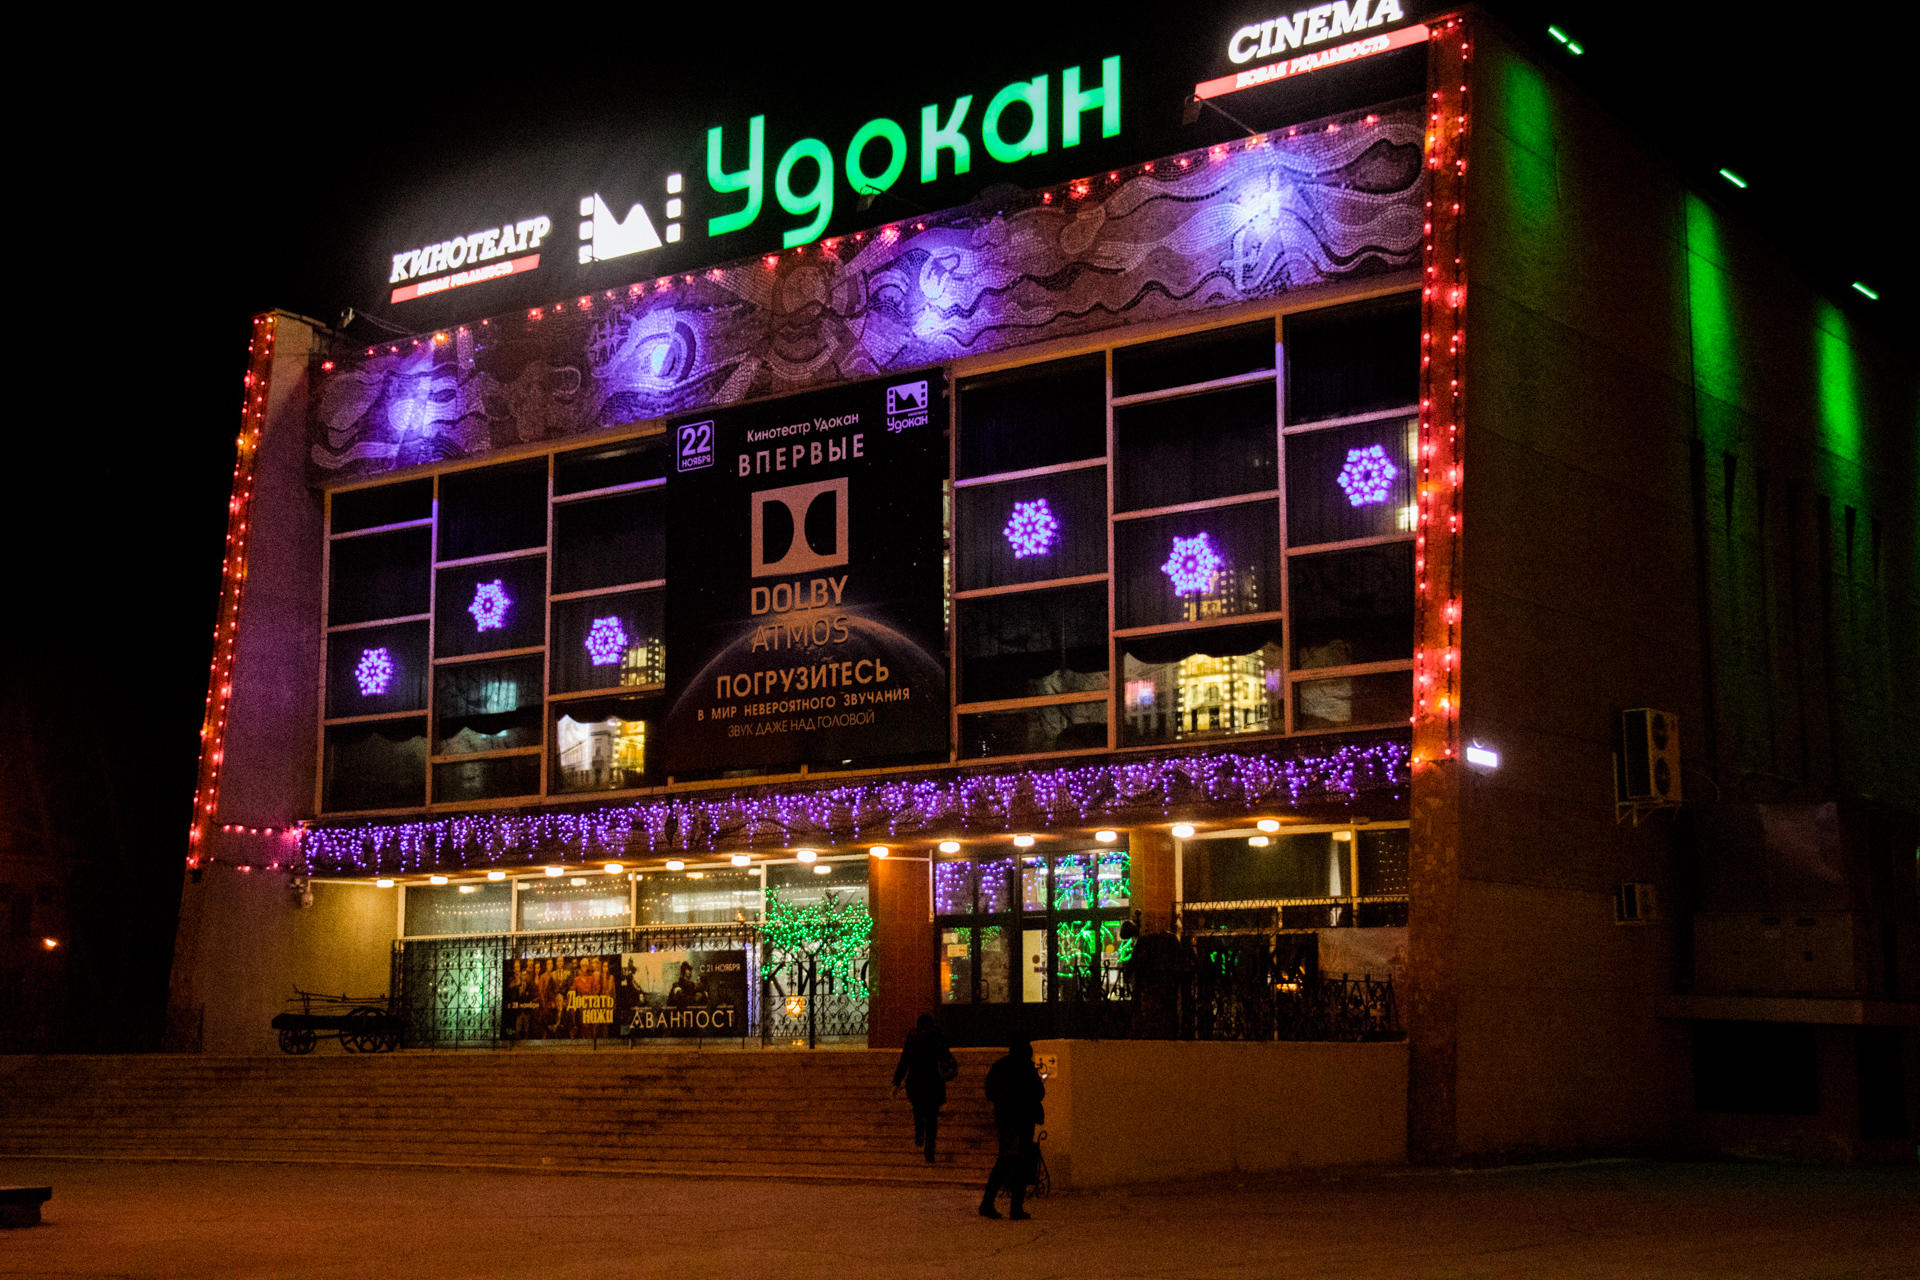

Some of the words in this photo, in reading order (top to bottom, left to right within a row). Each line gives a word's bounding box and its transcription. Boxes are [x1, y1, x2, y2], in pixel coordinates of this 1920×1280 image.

[1228, 0, 1404, 64] CINEMA
[707, 54, 1121, 250] Удокан
[389, 216, 551, 283] КИНОТЕАТР
[747, 420, 811, 443] Кинотеатр
[813, 412, 859, 431] Удокан
[887, 413, 928, 434] Удокан
[681, 424, 711, 457] 22
[738, 433, 864, 478] ВПЕРВЫЕ
[681, 454, 711, 469] НОЯБРЯ
[751, 575, 849, 616] DOLBY
[751, 617, 849, 653] ATMOS
[717, 658, 889, 699] ПОГРУЗИТЕСЬ
[697, 709, 704, 721] В
[711, 705, 737, 720] МИР
[744, 696, 836, 717] НЕВЕРОЯТНОГО
[843, 687, 910, 706] ЗВУЧАНИЯ
[728, 722, 753, 738] ЗВУК
[755, 719, 788, 736] ДАЖЕ
[790, 716, 816, 731] НАД
[817, 709, 875, 728] ГОЛОВОЙ
[567, 990, 614, 1011] Достать
[582, 1008, 614, 1024] ножи
[629, 1008, 735, 1029] АВАНПОСТ
